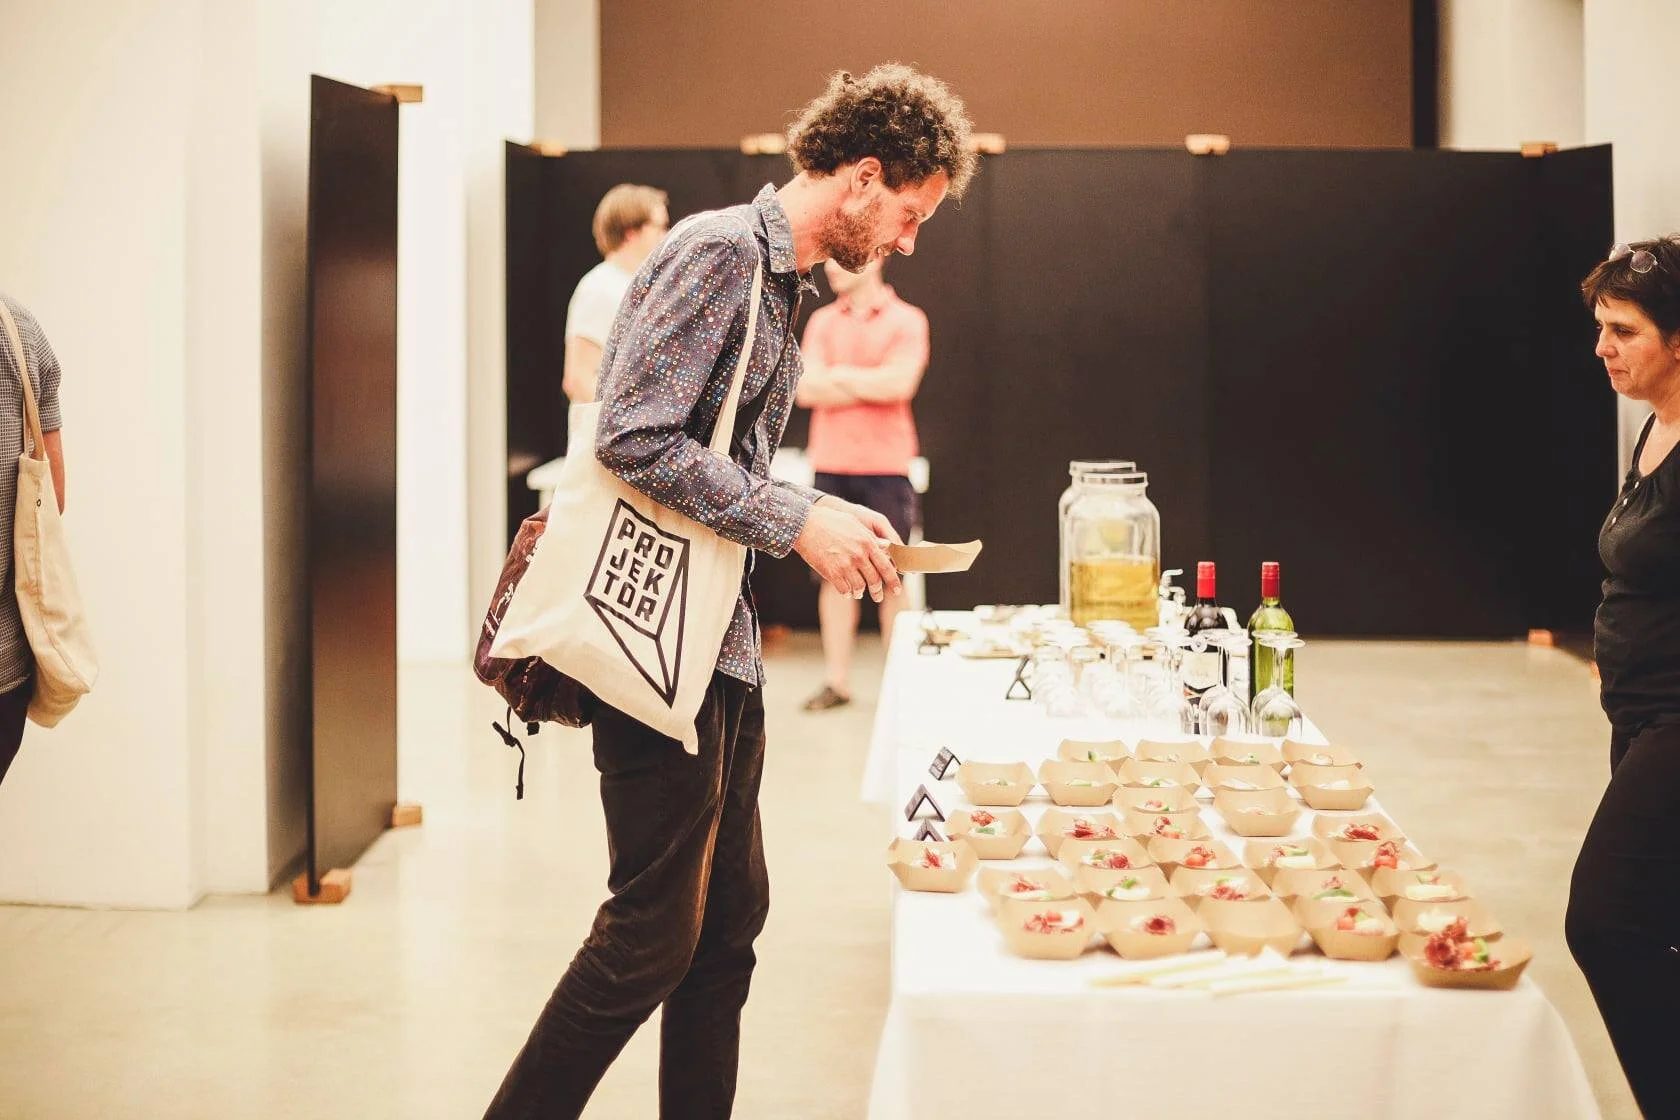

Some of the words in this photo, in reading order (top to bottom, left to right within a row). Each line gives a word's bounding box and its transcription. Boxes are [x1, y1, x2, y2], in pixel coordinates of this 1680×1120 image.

[617, 517, 674, 569] PRO
[603, 569, 657, 622] TOR
[610, 548, 664, 595] JEK
